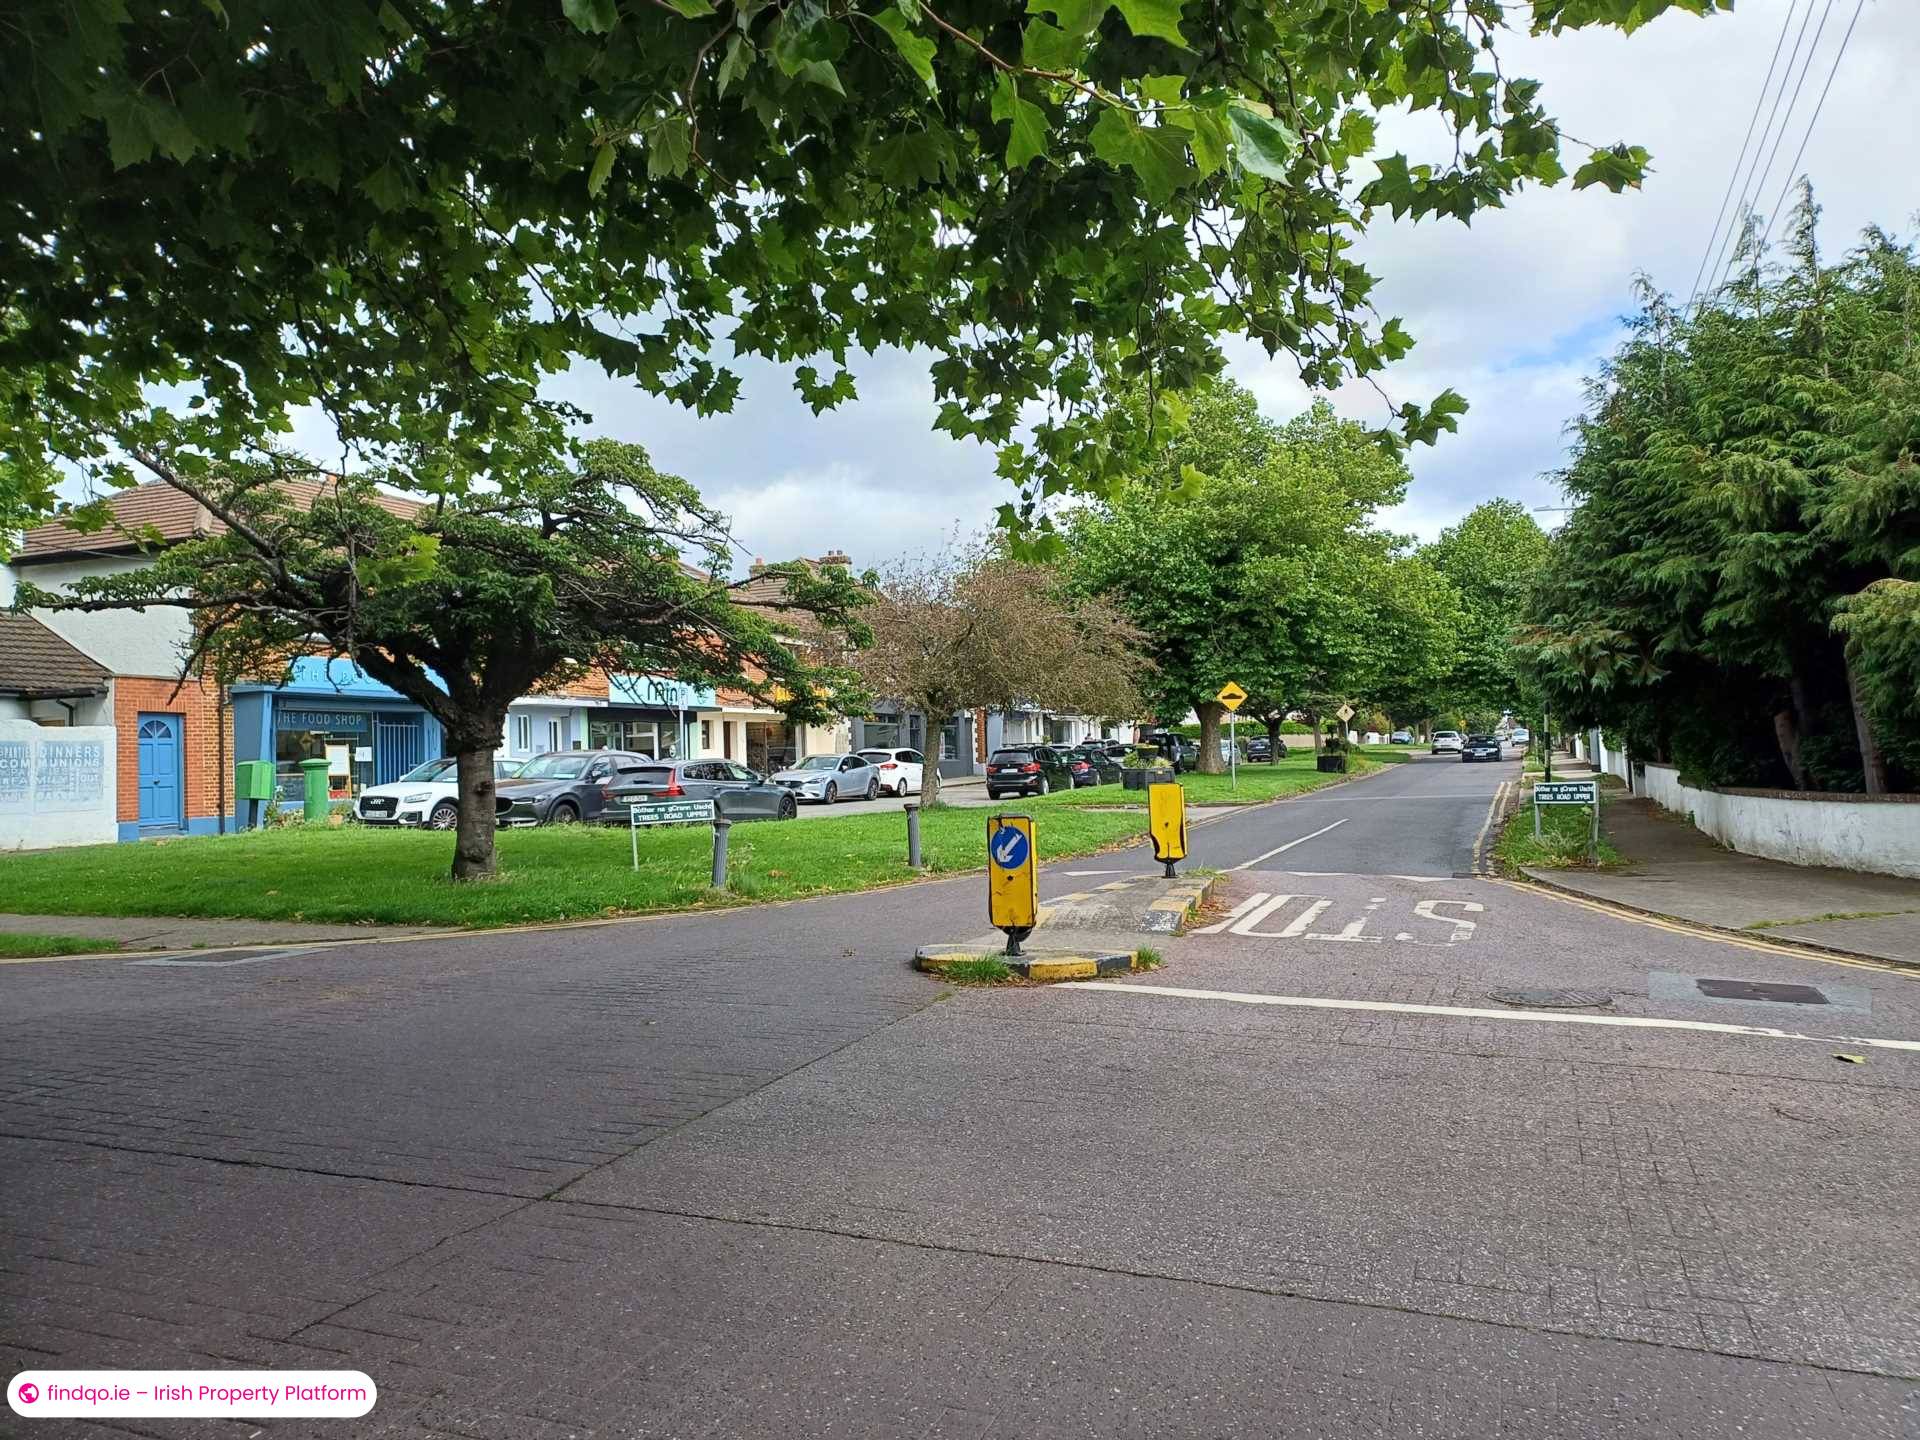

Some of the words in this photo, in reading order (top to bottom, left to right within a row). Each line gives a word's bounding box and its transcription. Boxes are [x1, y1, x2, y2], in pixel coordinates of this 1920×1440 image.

[277, 711, 297, 724] THE
[302, 712, 331, 724] FOOD
[335, 714, 362, 726] SHOP
[39, 745, 101, 758] DINNERS
[663, 812, 683, 820] ROAD
[686, 810, 709, 818] UPPER
